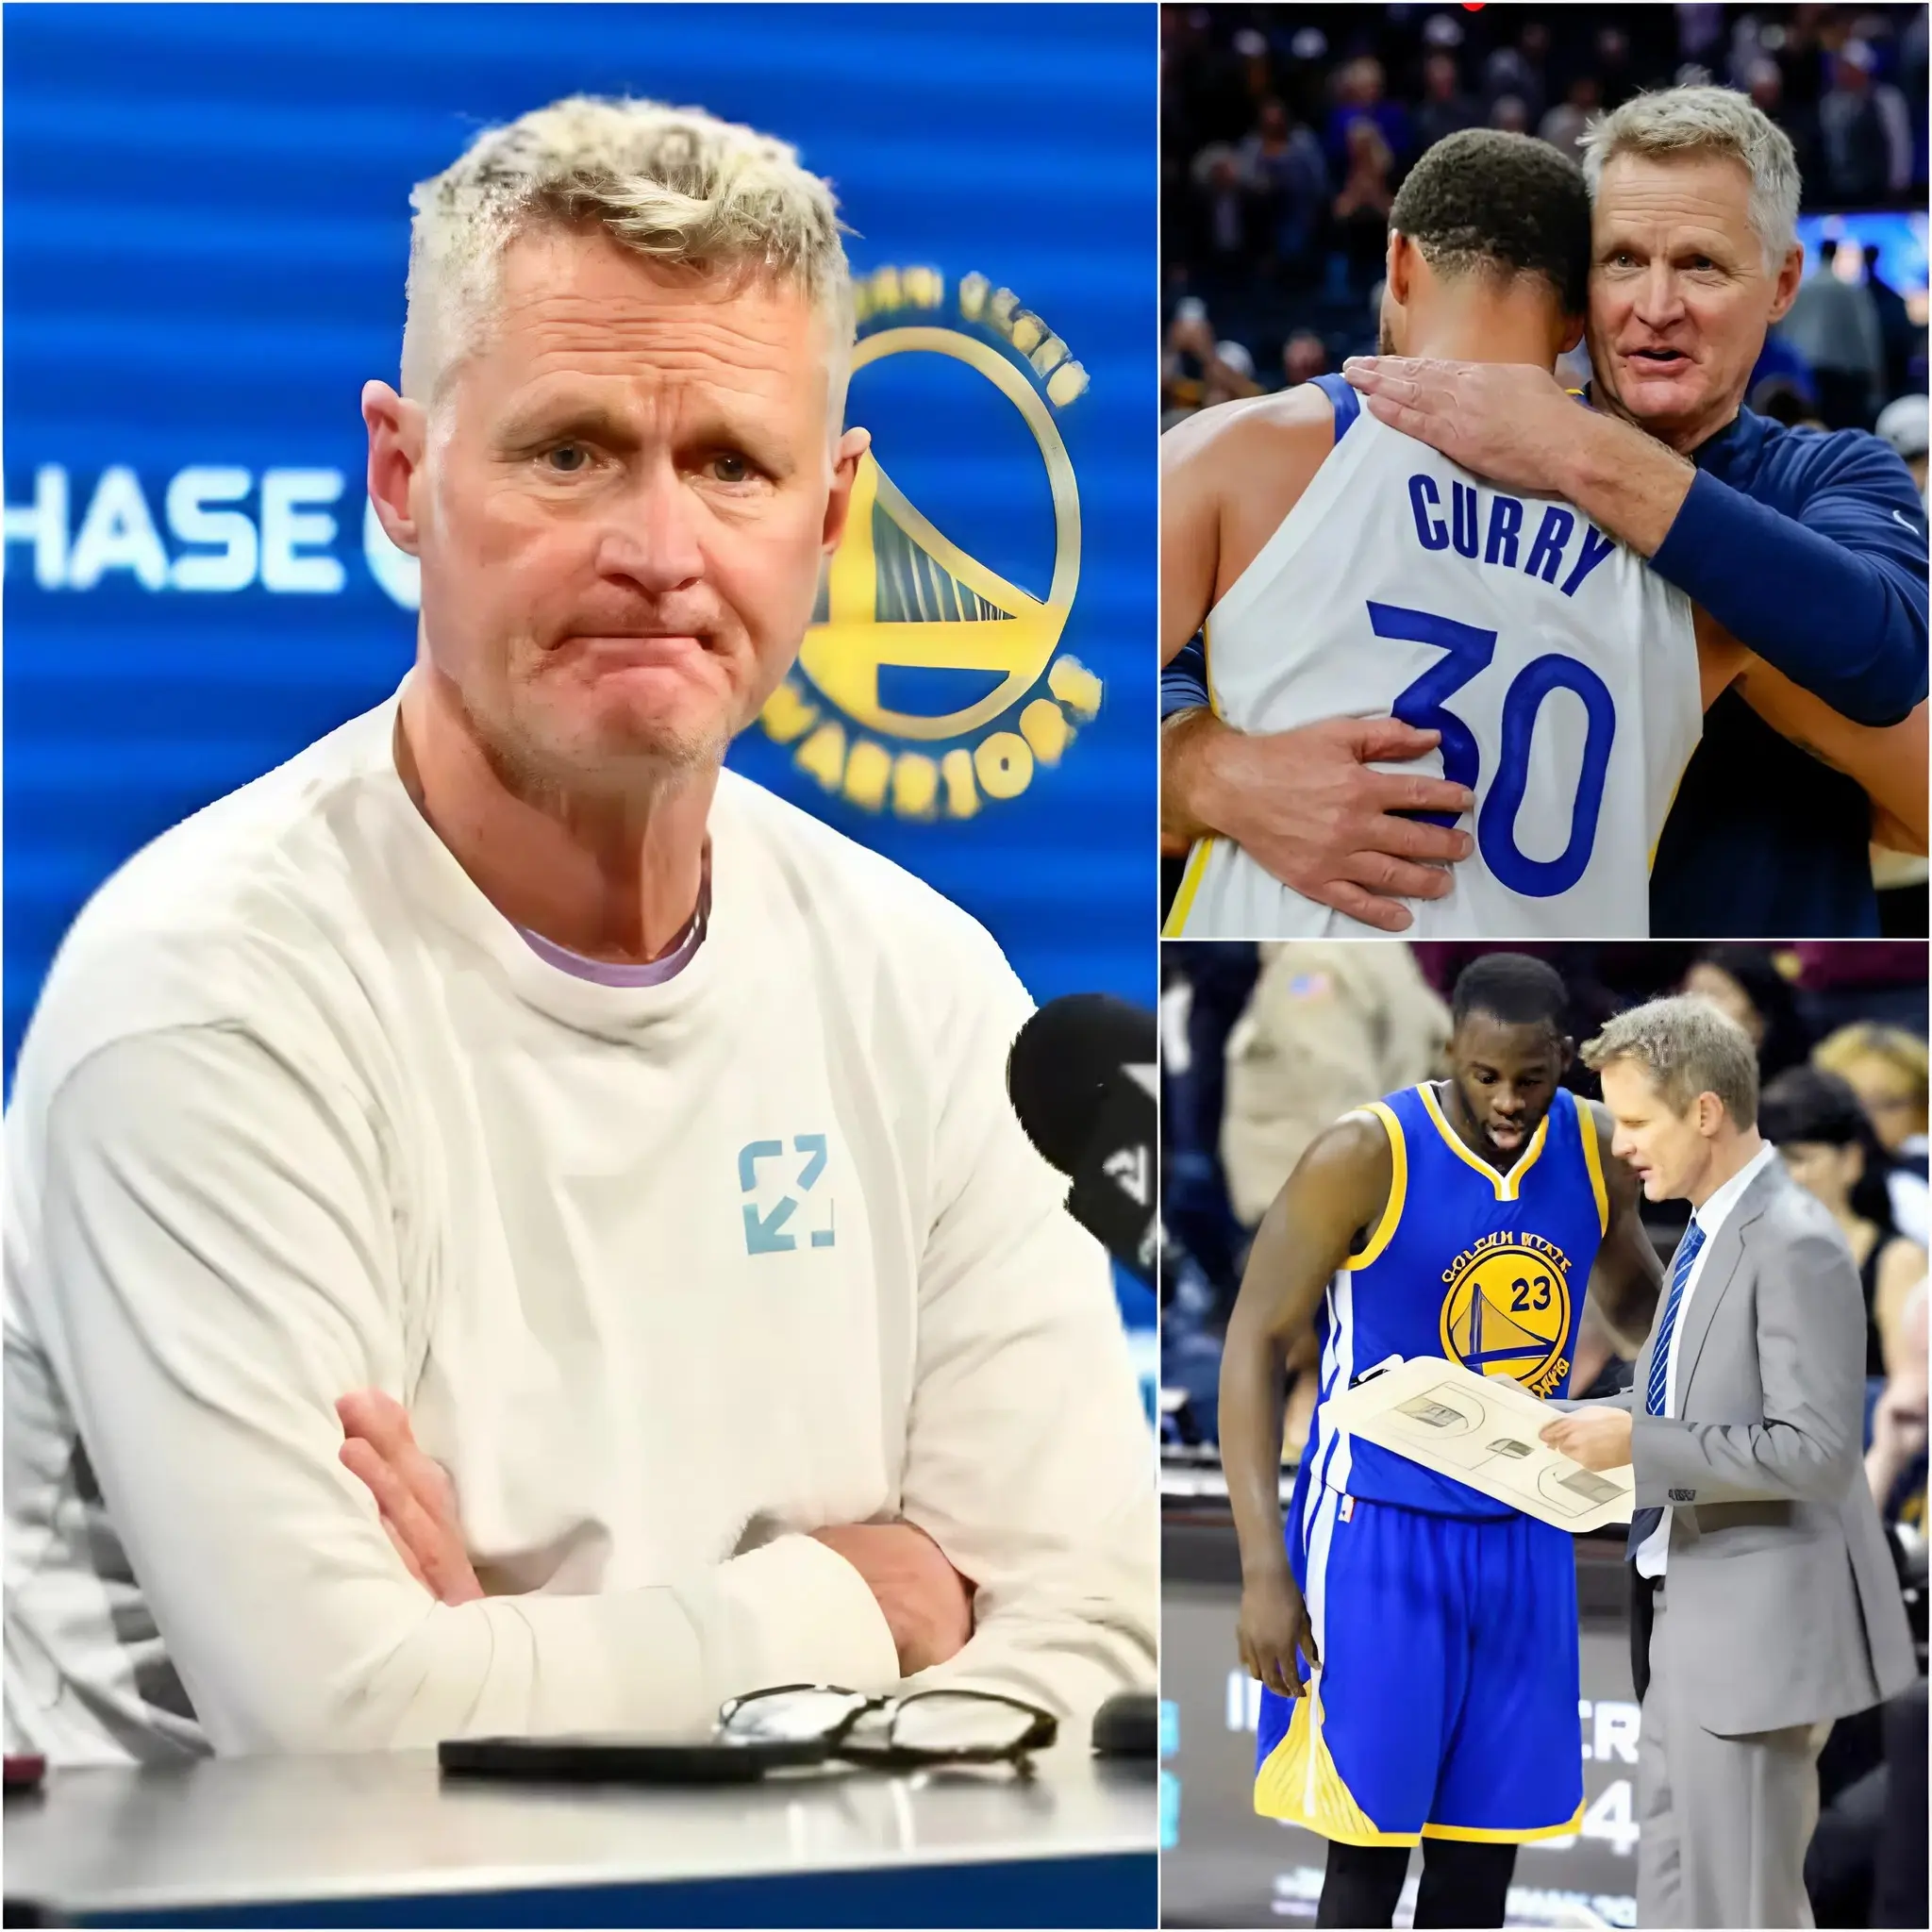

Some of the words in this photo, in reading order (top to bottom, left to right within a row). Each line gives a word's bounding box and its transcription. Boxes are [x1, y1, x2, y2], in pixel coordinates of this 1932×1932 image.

[1407, 474, 1616, 597] CURRY
[1366, 600, 1616, 897] 30
[1510, 1275, 1551, 1312] 23
